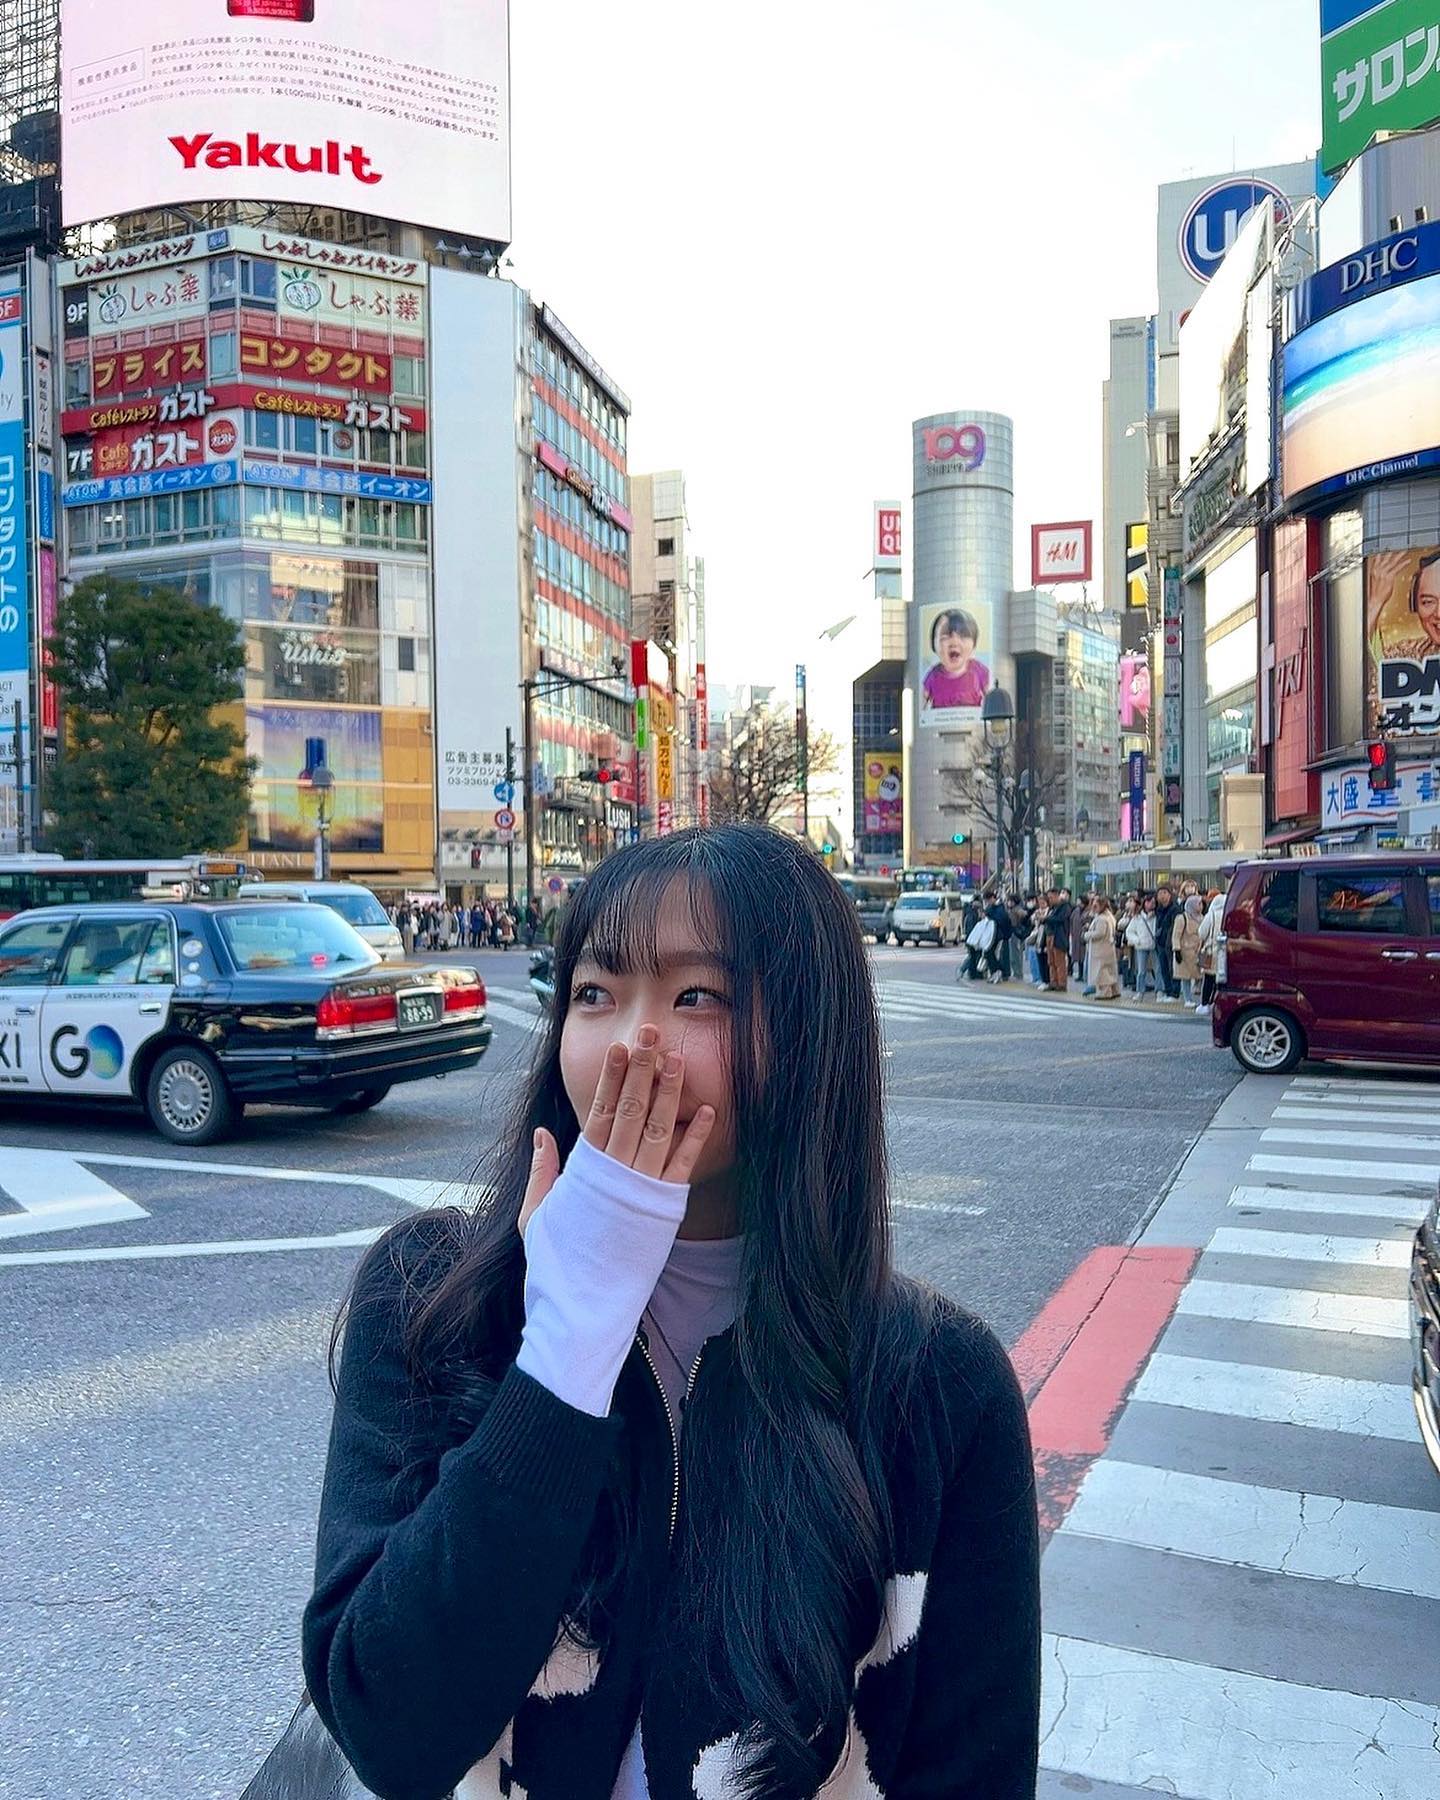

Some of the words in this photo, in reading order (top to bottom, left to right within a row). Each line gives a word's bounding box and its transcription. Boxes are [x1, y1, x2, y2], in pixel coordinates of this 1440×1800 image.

[1333, 24, 1440, 123] サロン
[168, 132, 383, 185] Yakult
[74, 236, 196, 278] しゃぶしゃぶバイキング
[262, 233, 418, 278] しゃぶしゃぶバイキング
[1341, 236, 1419, 294] DHC
[66, 301, 88, 324] 9F
[131, 273, 200, 312] しゃぶ葉
[331, 280, 421, 322] しゃぶ葉
[94, 343, 205, 389] プライス
[241, 337, 388, 385] コンタクト
[160, 387, 215, 422] ガスト
[344, 400, 413, 432] ガスト
[68, 449, 93, 473] 7F
[131, 430, 200, 472] ガスト
[924, 424, 985, 471] 109
[1371, 454, 1418, 477] Channel
[110, 467, 208, 496] 英会話イーオン
[304, 469, 429, 498] 英会話イーオン
[1046, 541, 1077, 562] H&M
[605, 800, 632, 829] LUSH
